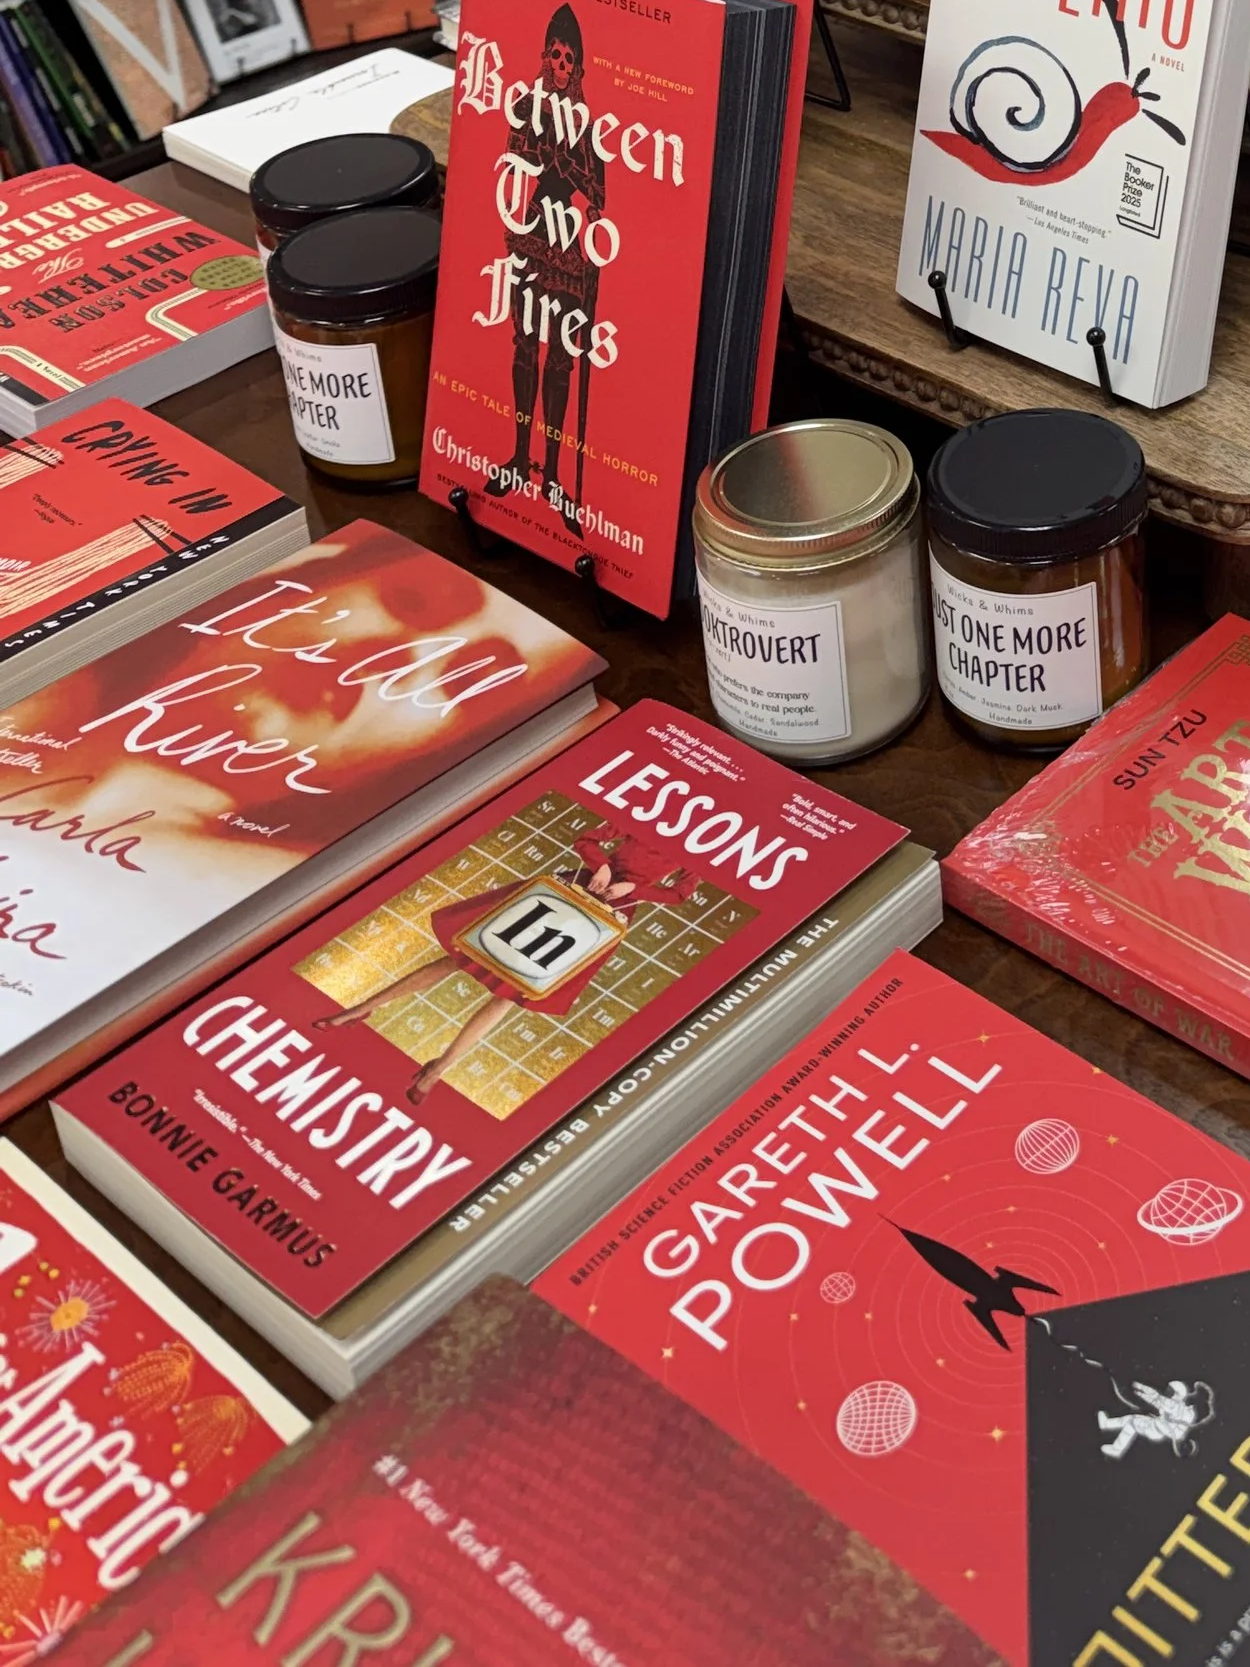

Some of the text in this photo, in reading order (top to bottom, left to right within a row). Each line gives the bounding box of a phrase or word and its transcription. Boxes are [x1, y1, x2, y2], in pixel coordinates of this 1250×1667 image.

[457, 30, 684, 188] Between
[1160, 55, 1185, 72] NOVEL
[494, 152, 622, 269] Two
[1121, 192, 1142, 208] 2025
[1122, 182, 1143, 197] Prize
[1124, 172, 1155, 192] Booker
[1125, 161, 1141, 176] The
[48, 269, 190, 333] COLSON
[471, 253, 619, 370] Fires
[919, 195, 1139, 365] MARIA REVA
[61, 420, 234, 514] CRYING IN
[432, 372, 659, 487] AN EPIC TALE OF MEDIEVAL HORROR
[431, 424, 645, 555] Christopher Buehlman
[177, 578, 529, 720] It's All
[700, 604, 821, 664] OKTROVERT
[947, 583, 1034, 616] Wicks & Whims
[961, 614, 1087, 655] ONE MORE
[948, 642, 1046, 692] CHAPTER
[80, 662, 333, 796] River
[1113, 708, 1207, 792] SUN TZU
[579, 750, 808, 891] LESSONS
[1126, 823, 1179, 867] THE
[498, 900, 581, 973] In
[180, 995, 472, 1211] CHEMISTRY
[450, 915, 838, 1232] THE MULTIMILLION-COPY BESTSELLER
[108, 1082, 336, 1272] BONNIE GARMUS
[642, 1043, 919, 1279] GARETH L.
[669, 1055, 1002, 1351] POWELL
